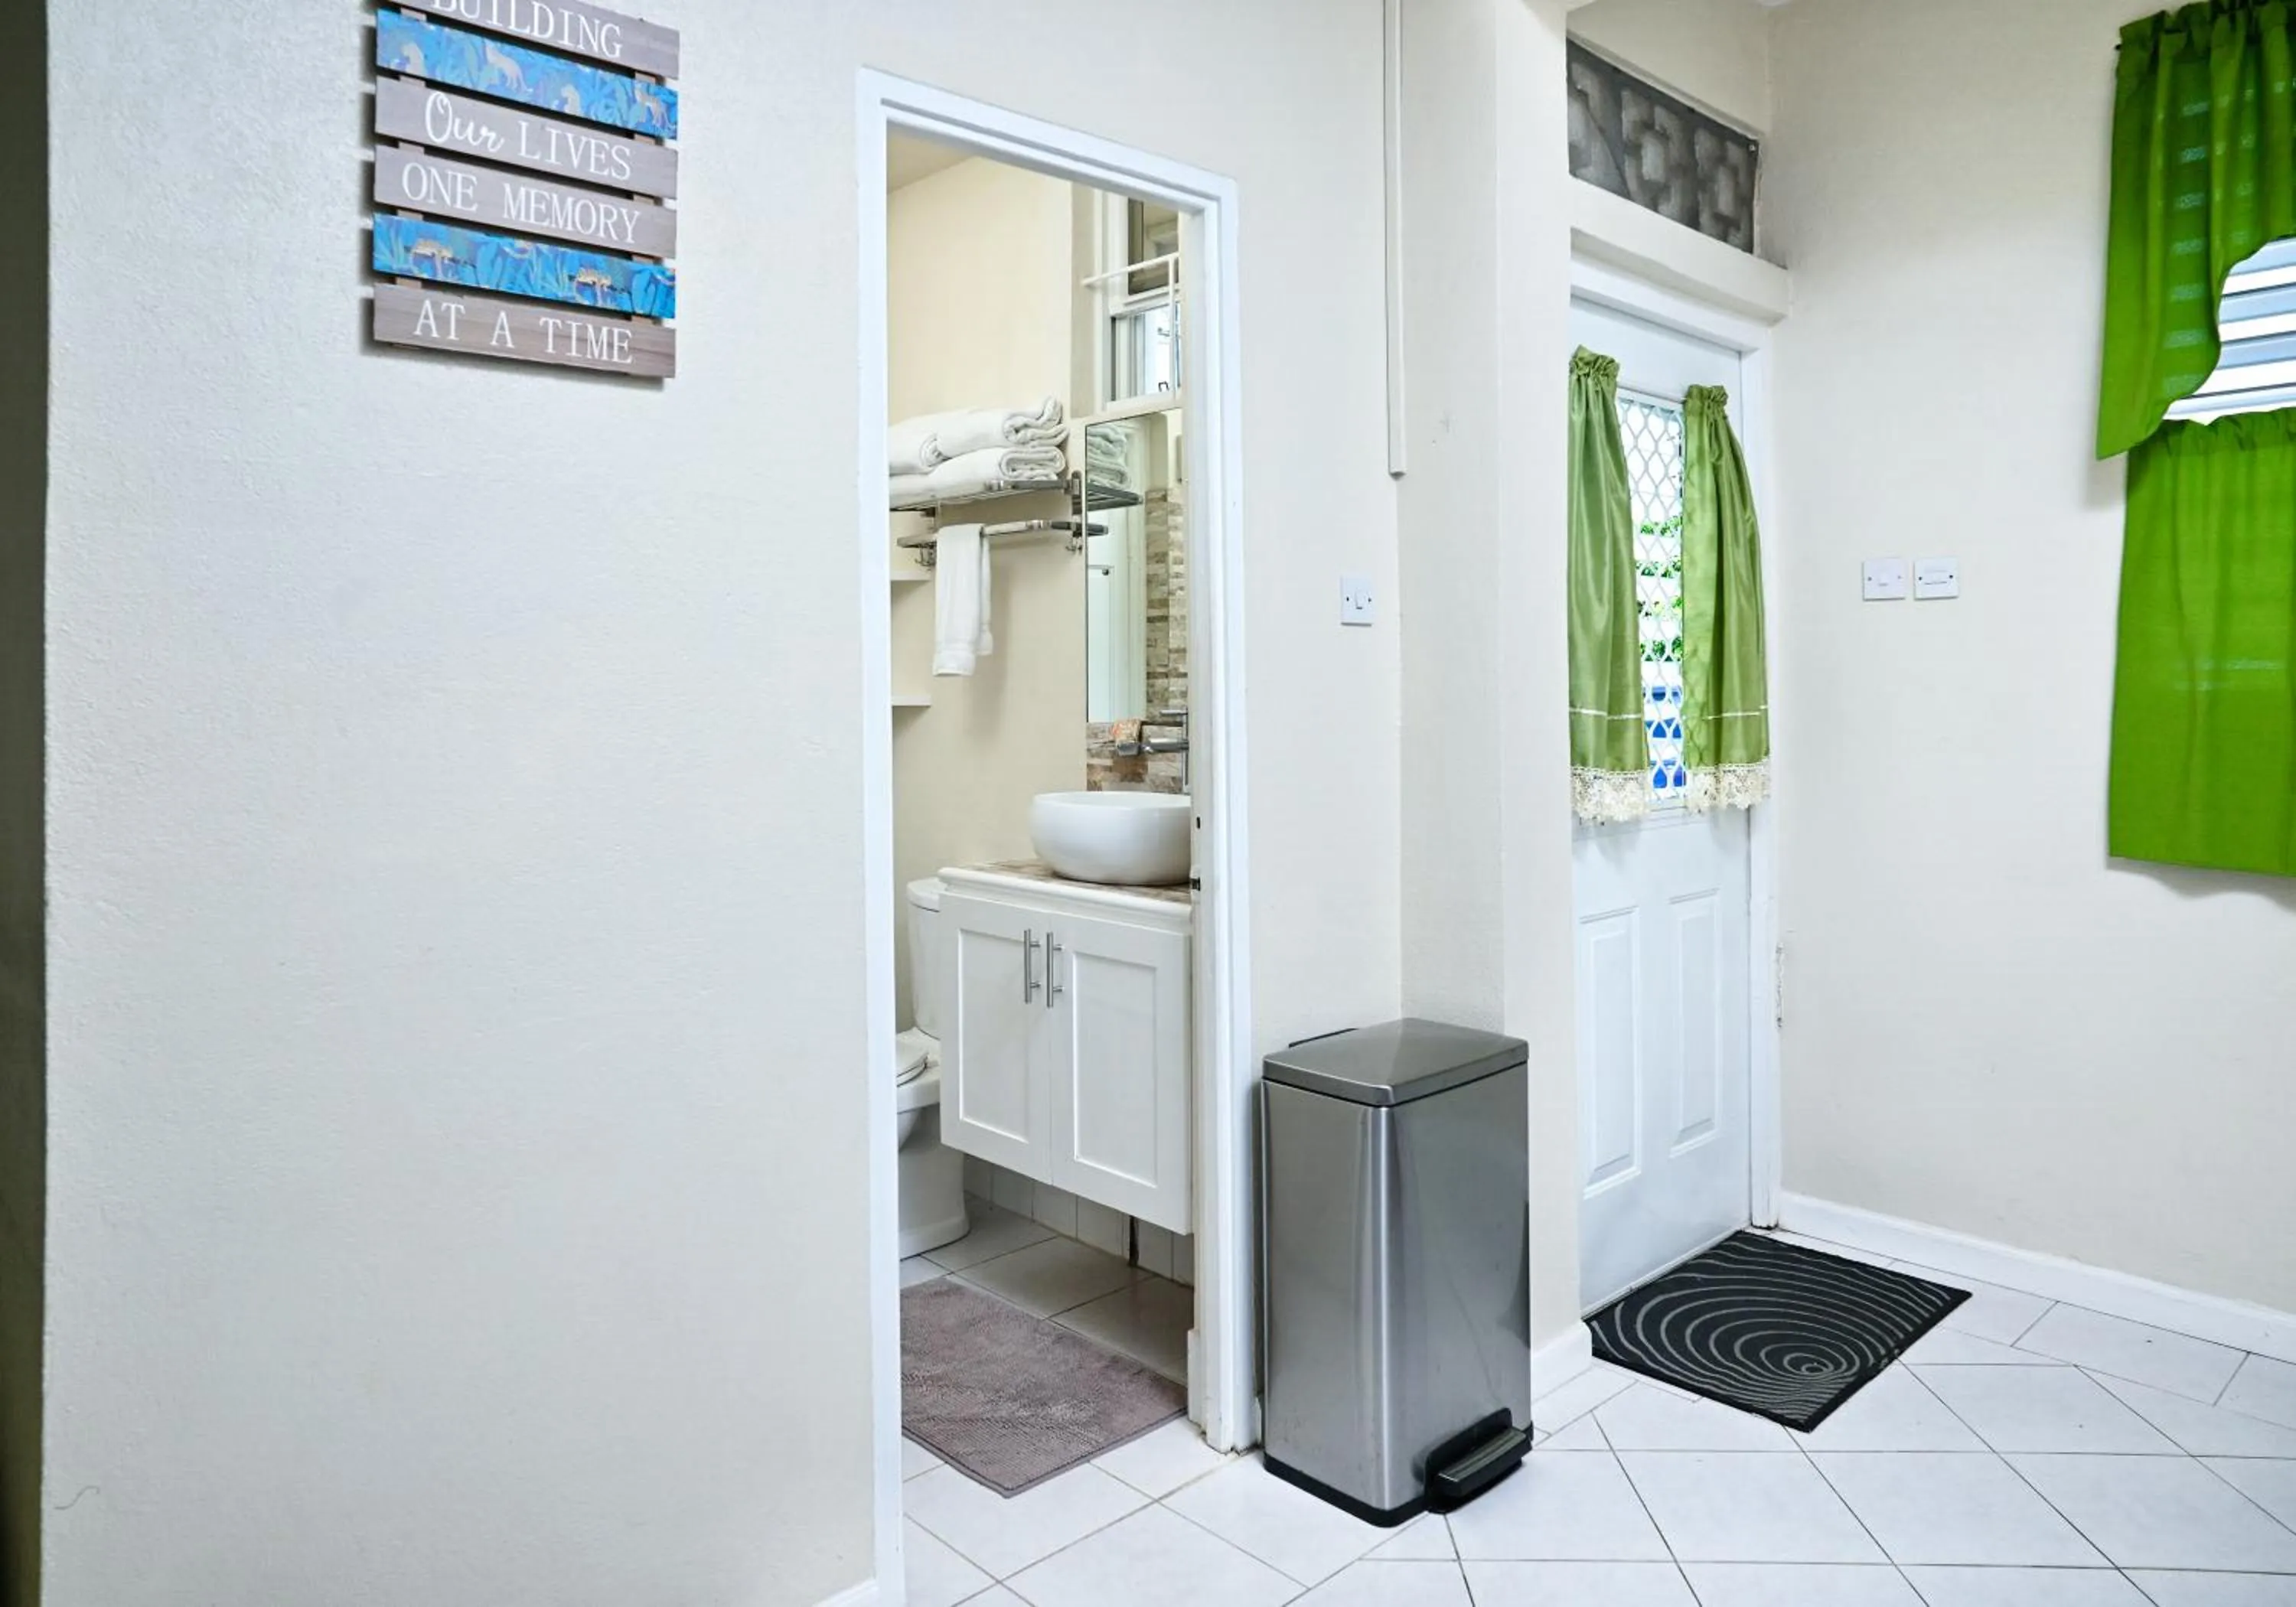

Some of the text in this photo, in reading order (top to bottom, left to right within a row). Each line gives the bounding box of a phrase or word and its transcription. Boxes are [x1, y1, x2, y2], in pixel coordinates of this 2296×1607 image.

[425, 90, 631, 181] Our LIVES
[402, 162, 641, 243] ONE MEMORY
[413, 299, 632, 363] AT A TIME
